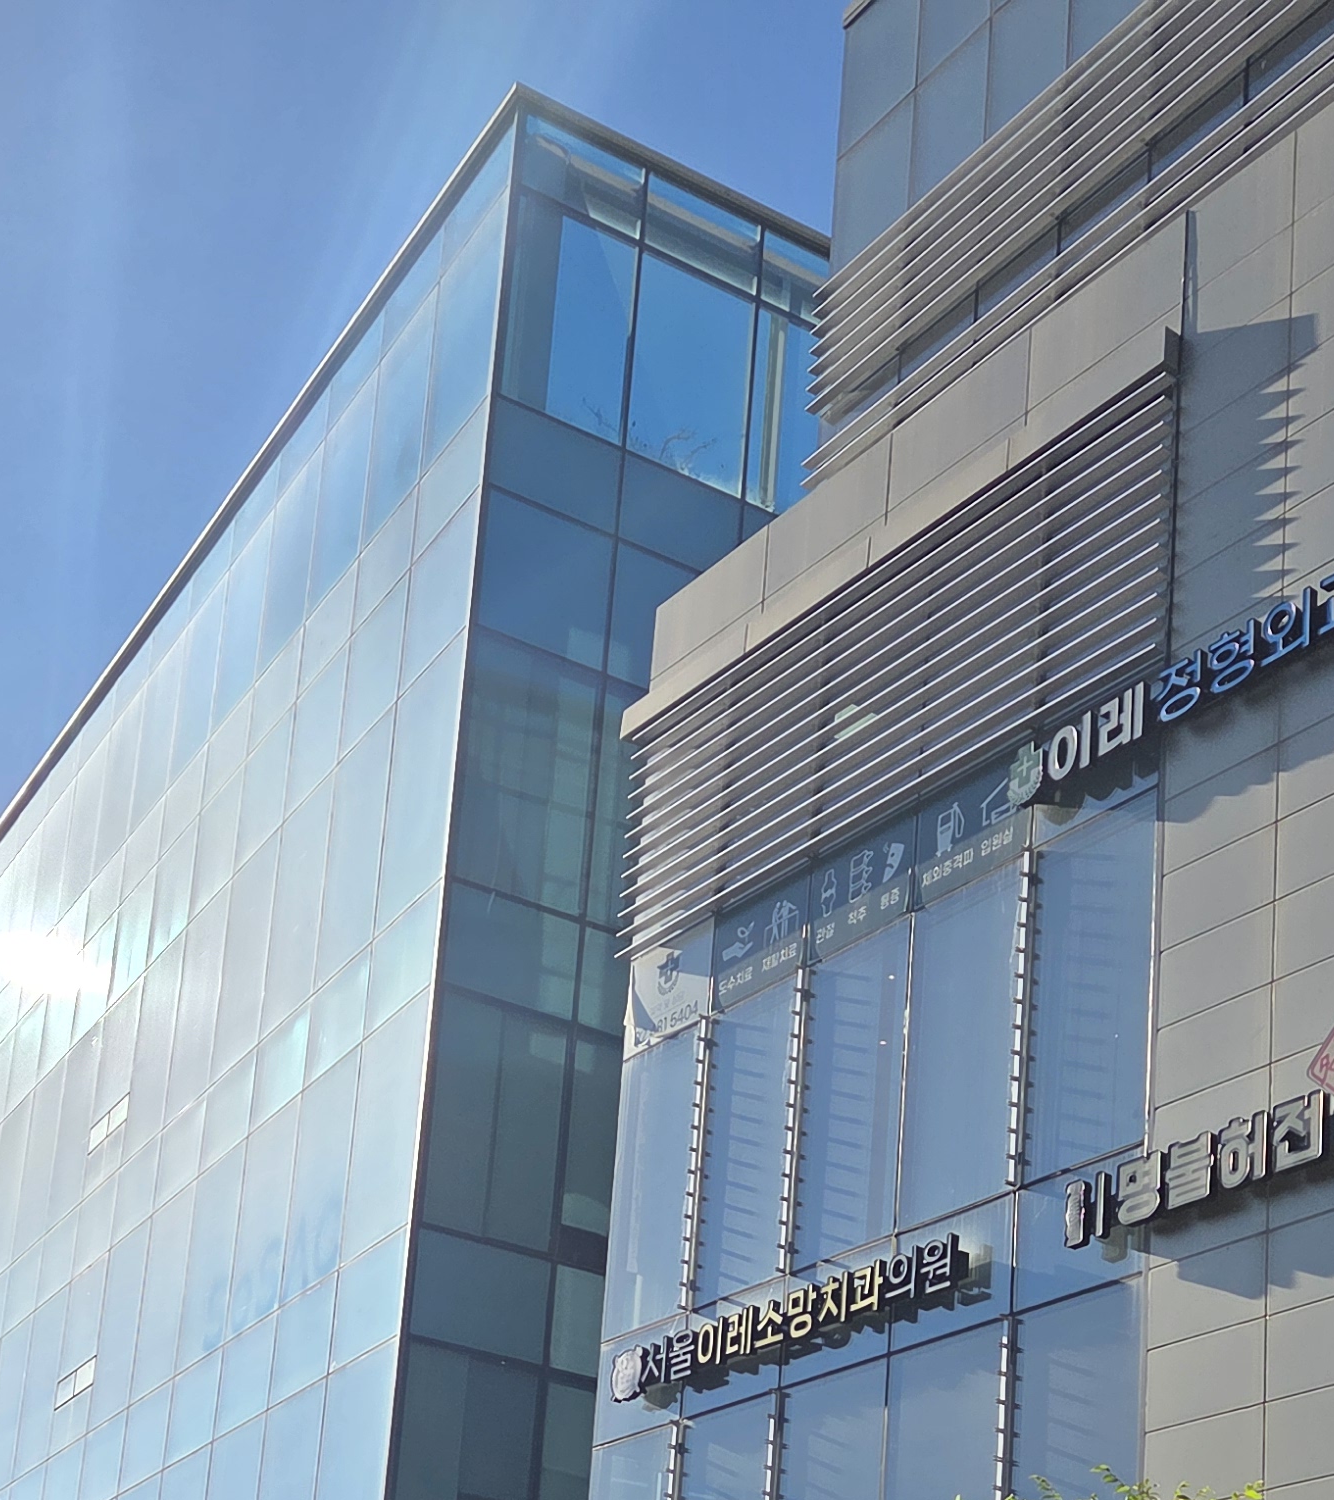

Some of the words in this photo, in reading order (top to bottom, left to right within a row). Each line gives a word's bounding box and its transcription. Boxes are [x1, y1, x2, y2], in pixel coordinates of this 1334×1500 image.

[921, 849, 974, 888] 체외충격파
[980, 826, 1014, 857] 입원실
[718, 966, 754, 996] 도수치료
[670, 1000, 699, 1028] 5404
[1117, 1090, 1328, 1228] 명불허전
[640, 1232, 957, 1384] 서울이레소망치과의원
